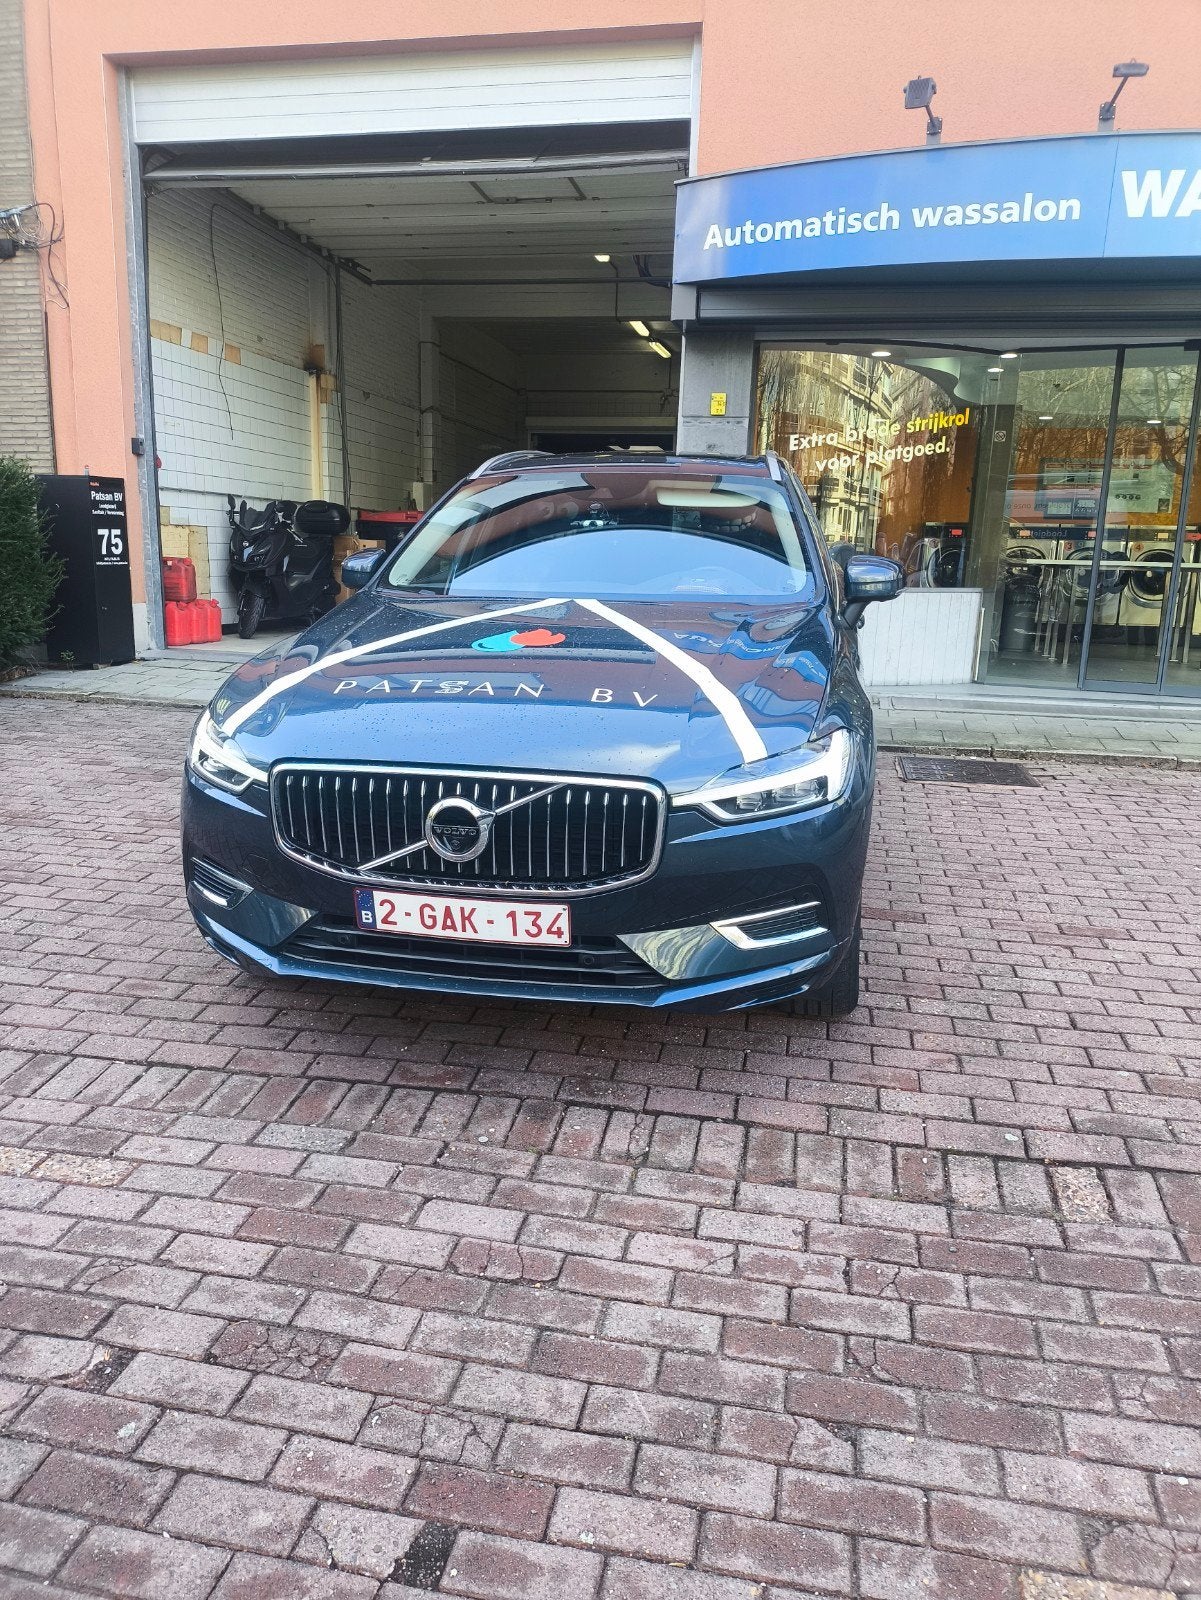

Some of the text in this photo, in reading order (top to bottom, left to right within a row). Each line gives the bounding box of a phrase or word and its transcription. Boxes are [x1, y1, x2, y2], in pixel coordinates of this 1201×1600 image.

[703, 192, 1082, 251] Automatisch wassalon
[788, 407, 970, 452] Extra brede strijkrol
[815, 436, 951, 473] voor platgoed.
[91, 491, 123, 502] Patsan BV
[97, 528, 123, 555] 75
[333, 679, 546, 698] PATSAN
[433, 826, 477, 836] VOLVO
[361, 910, 374, 923] B
